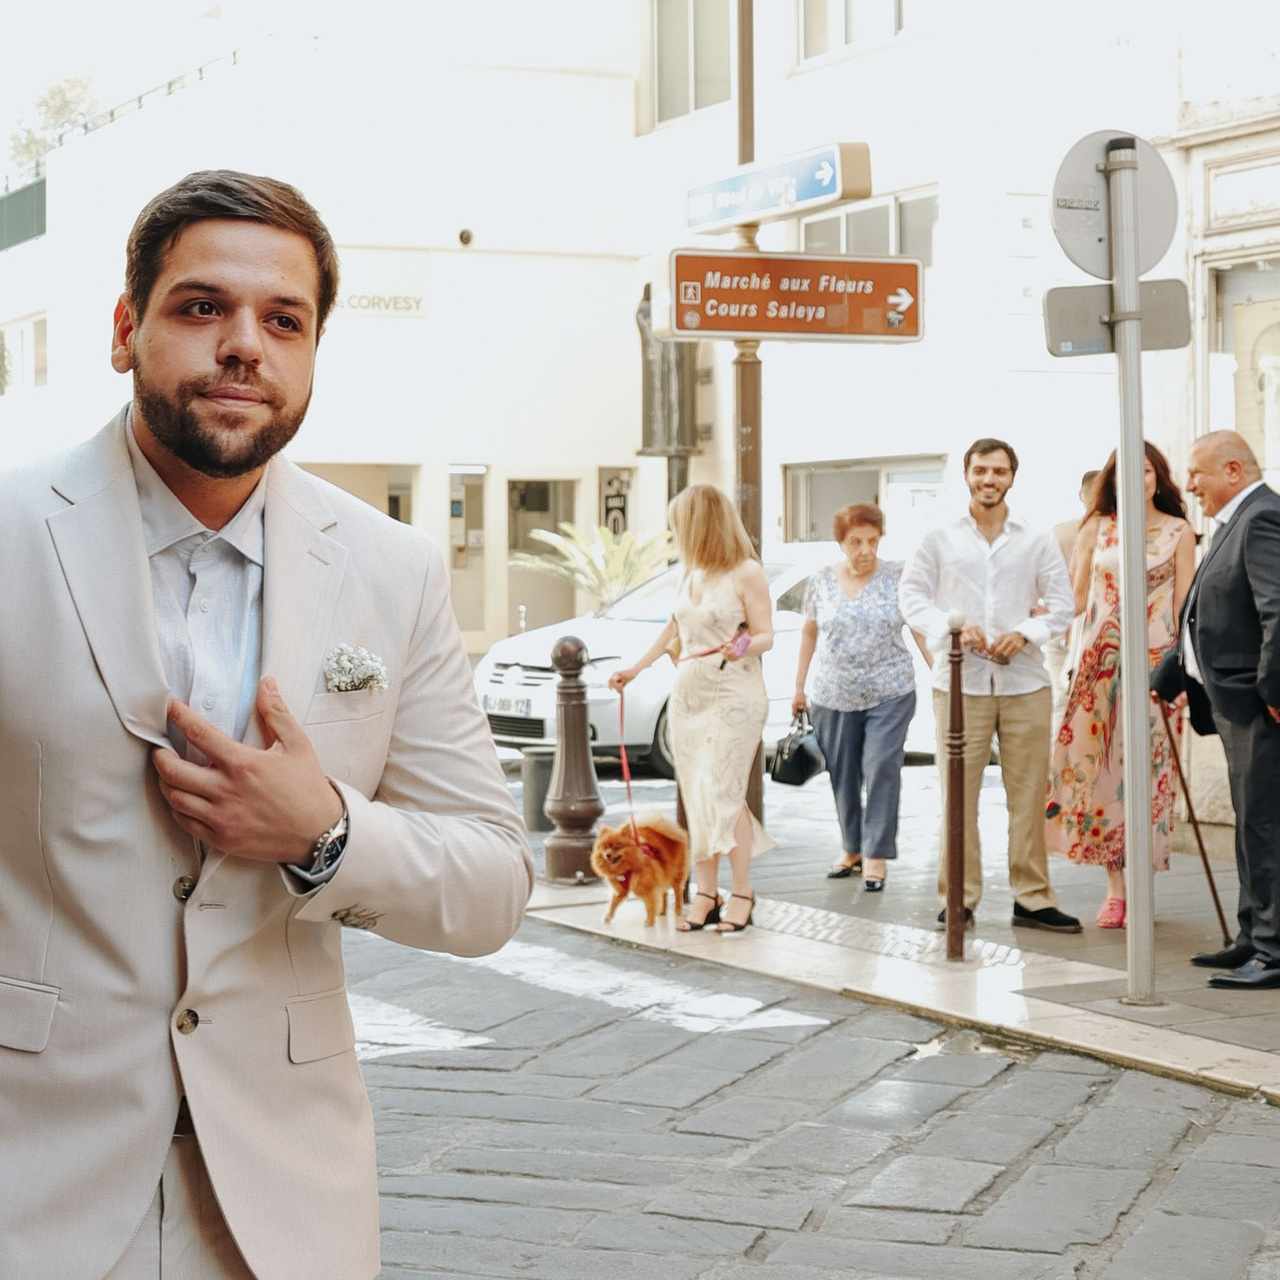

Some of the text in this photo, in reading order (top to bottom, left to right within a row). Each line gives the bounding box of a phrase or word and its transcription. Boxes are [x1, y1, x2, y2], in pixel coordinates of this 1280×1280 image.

[704, 271, 874, 294] Marché aux Fleurs
[347, 294, 423, 311] CORVESY
[704, 299, 826, 322] Cours Saleya
